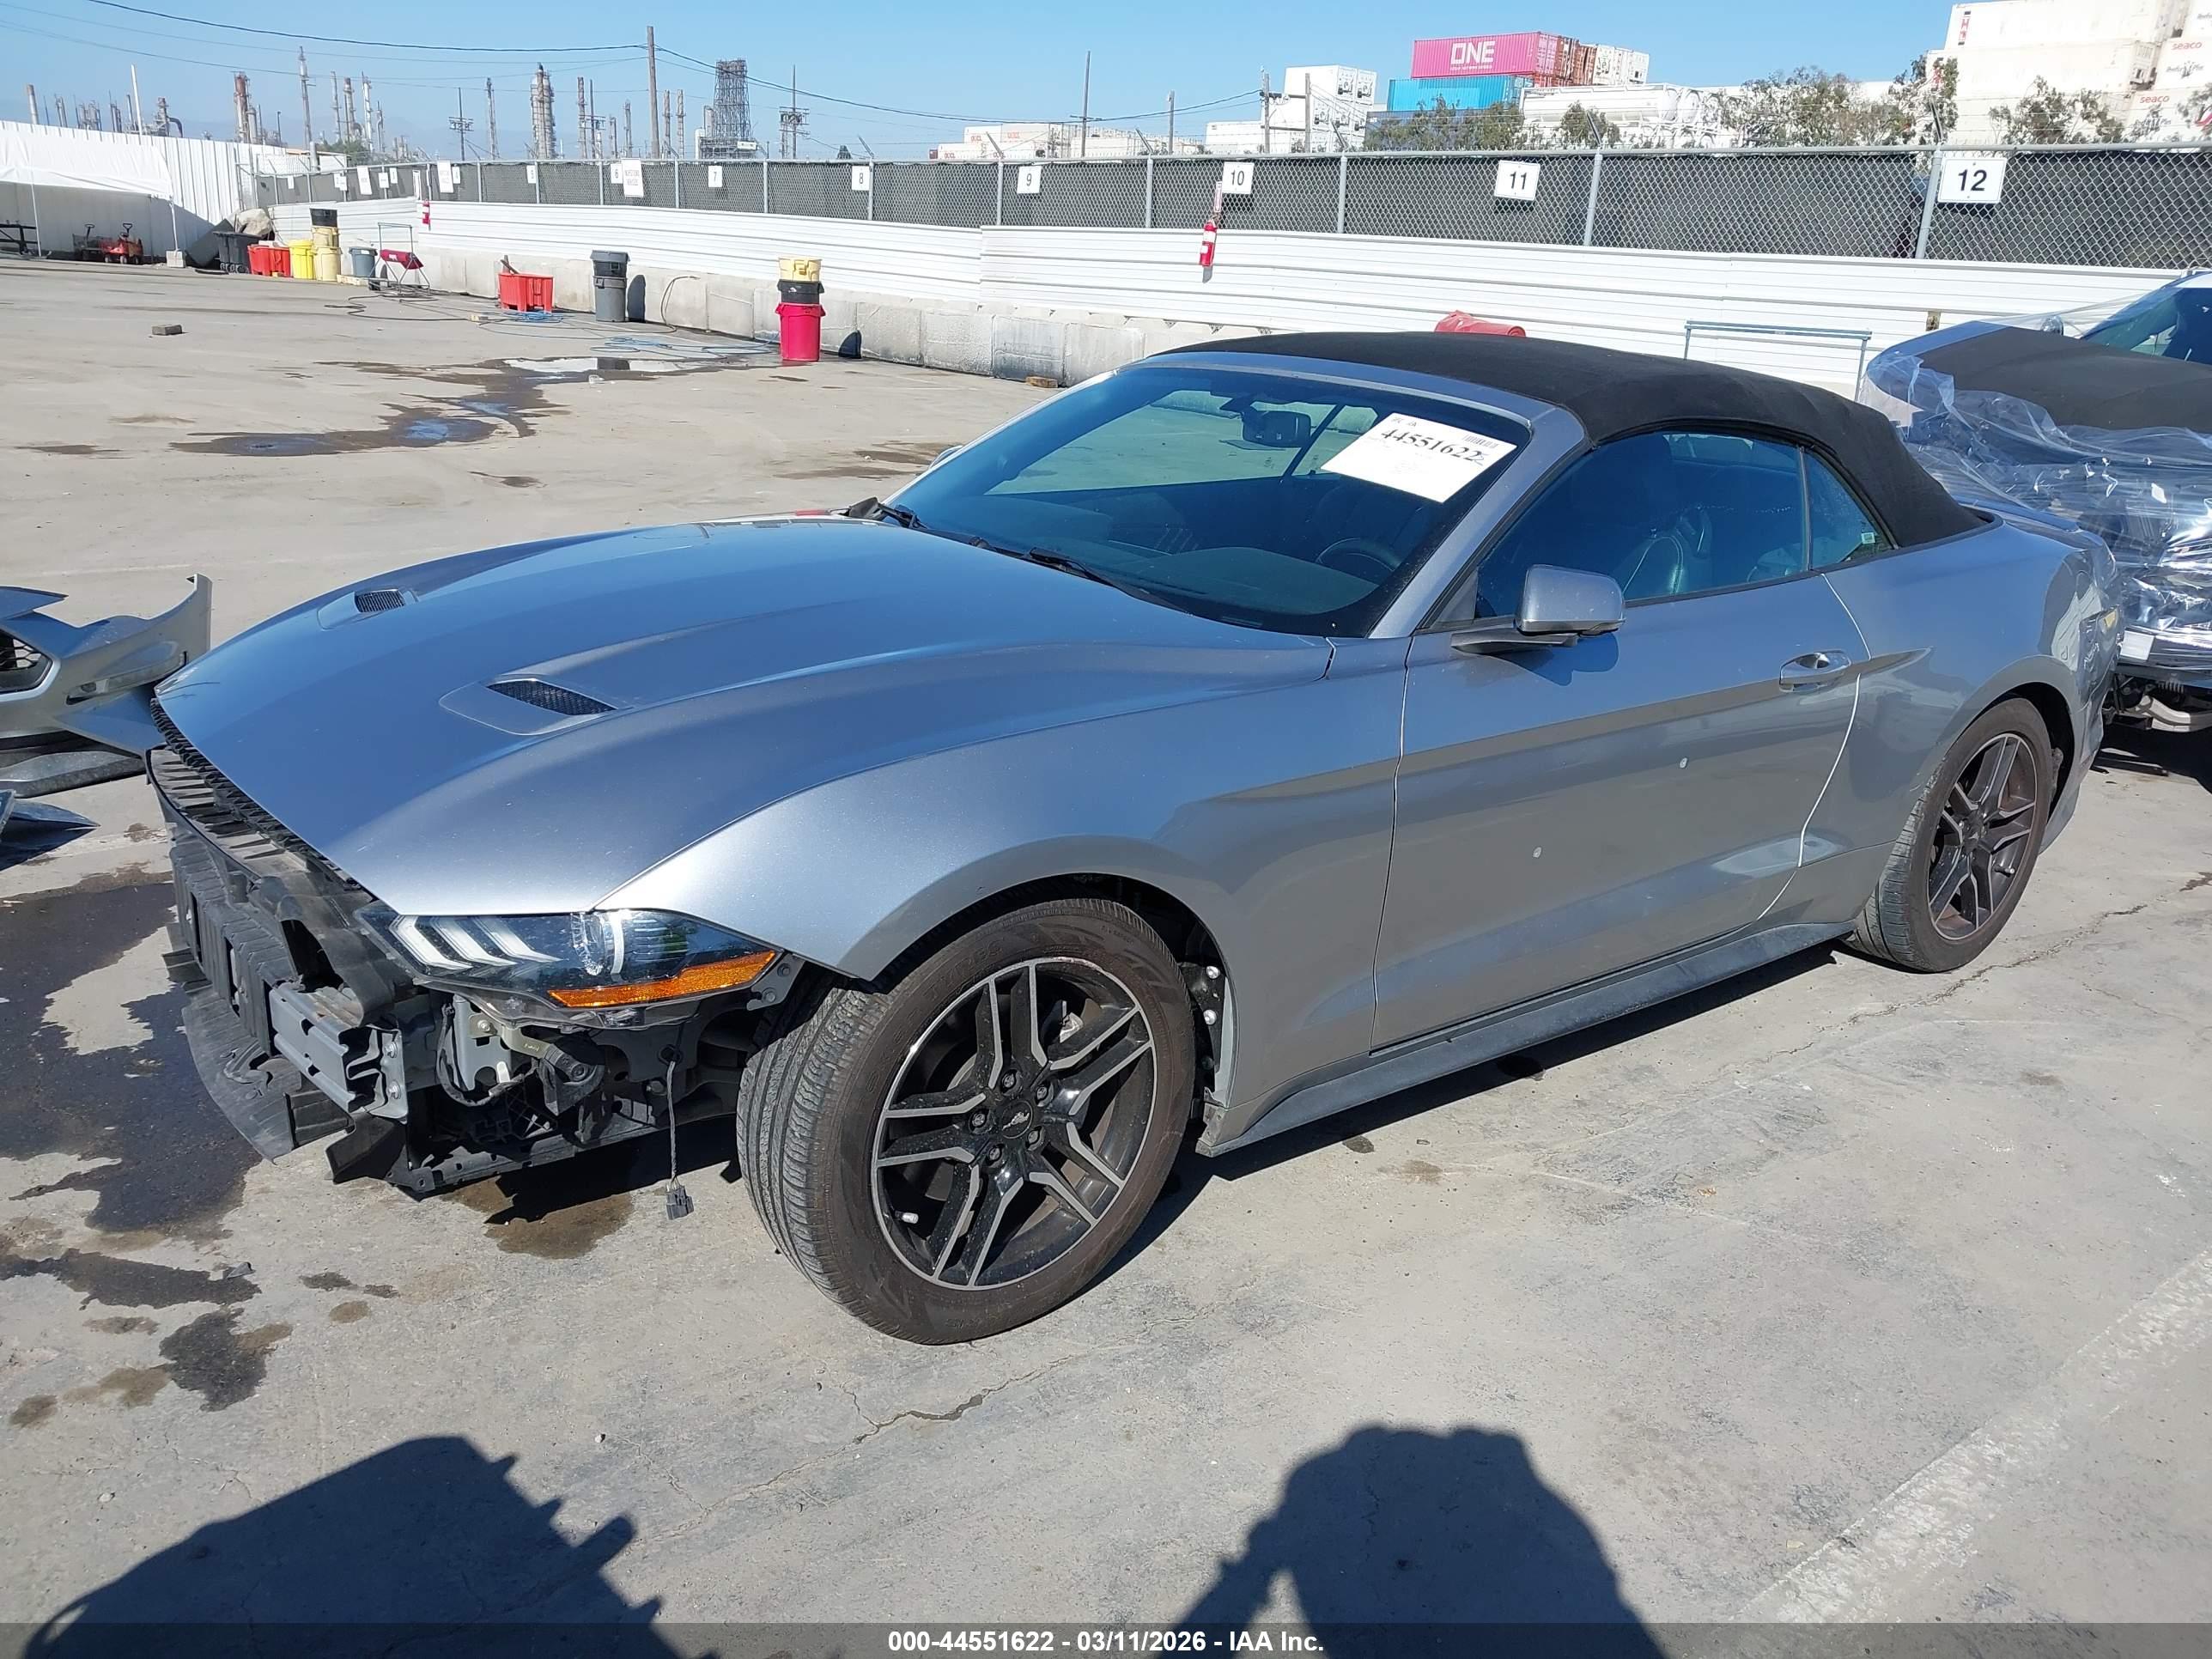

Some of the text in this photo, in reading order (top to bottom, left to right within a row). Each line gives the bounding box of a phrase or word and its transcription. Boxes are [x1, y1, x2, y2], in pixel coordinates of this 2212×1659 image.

[1450, 40, 1496, 64] ONE
[2172, 41, 2203, 50] seaco
[714, 171, 718, 182] 7
[859, 172, 864, 184] 8
[1026, 173, 1032, 186] 9
[1231, 170, 1244, 185] 10
[1510, 171, 1527, 190] 11
[1958, 169, 1987, 191] 12
[1381, 428, 1483, 461] 44551622
